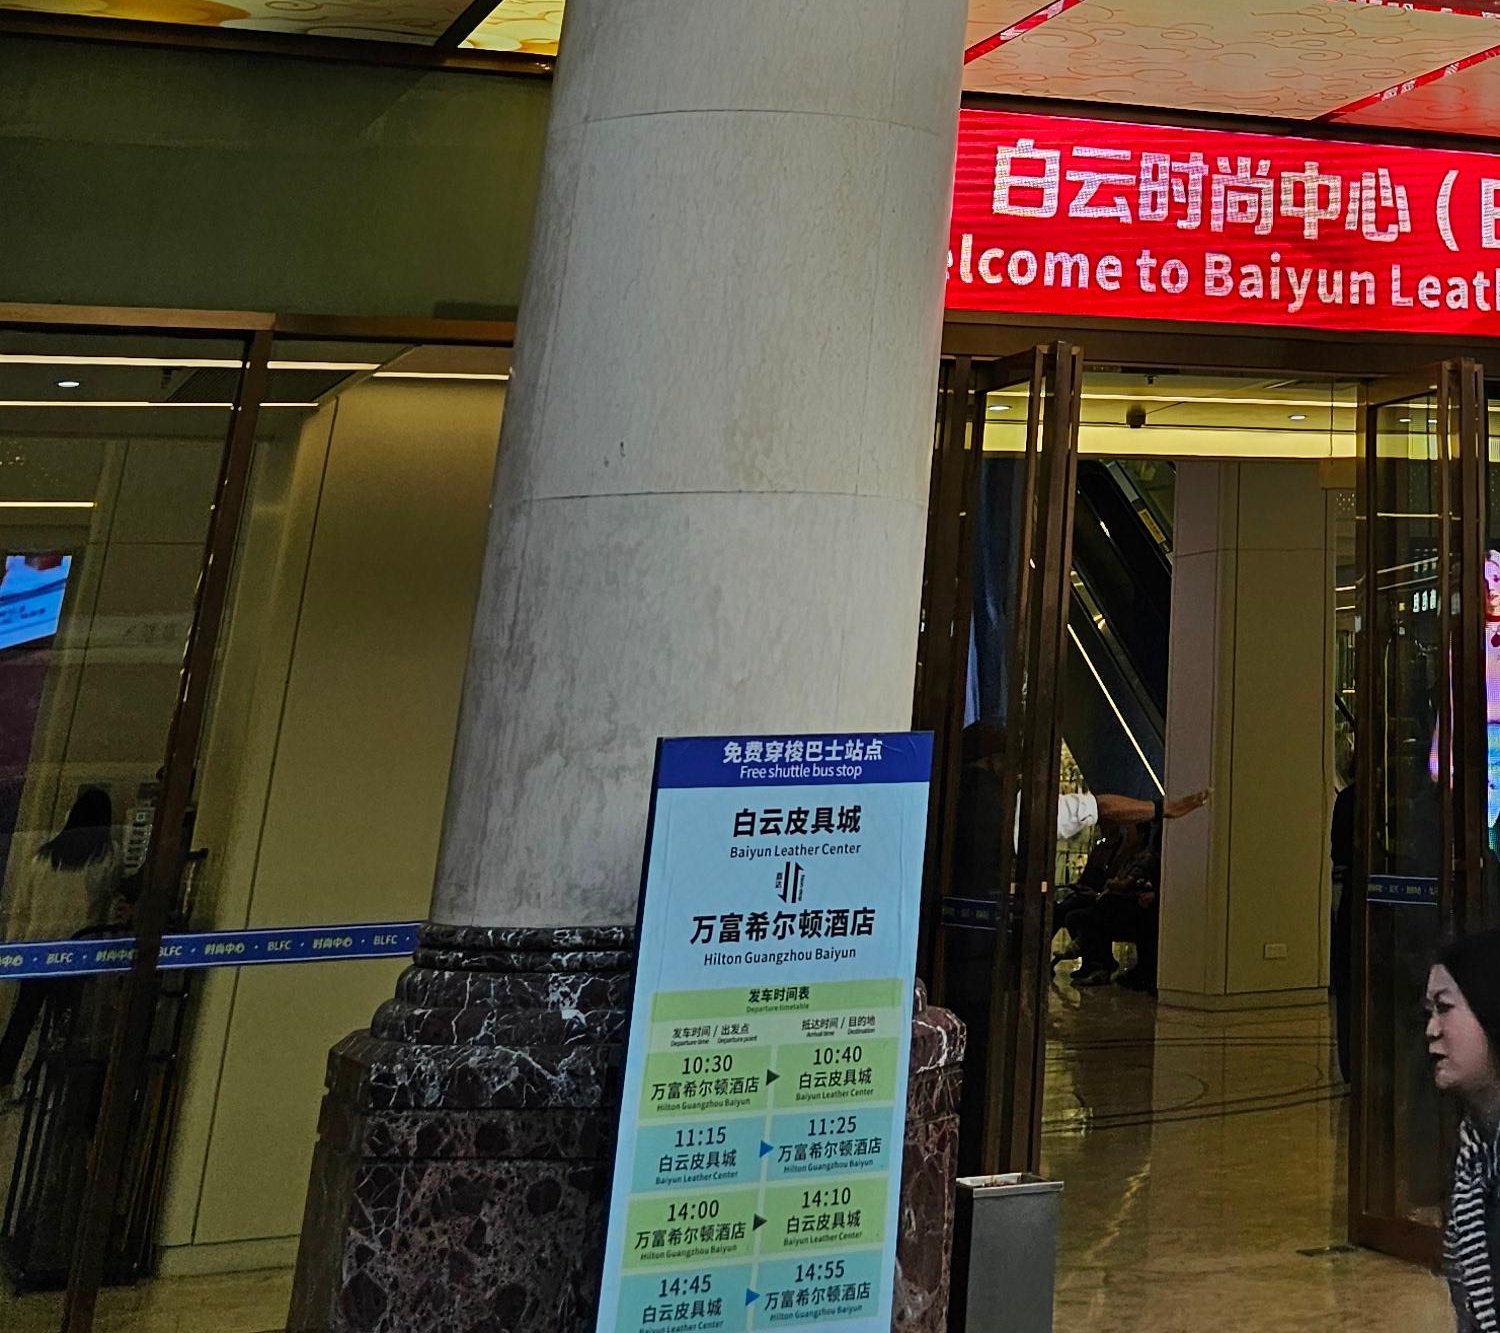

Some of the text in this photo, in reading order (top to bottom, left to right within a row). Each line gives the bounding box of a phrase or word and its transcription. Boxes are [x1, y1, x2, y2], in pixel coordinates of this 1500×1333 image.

[1137, 249, 1189, 294] to
[1203, 251, 1376, 313] Baiyun
[723, 740, 883, 764] 免费穿梭巴士站点
[740, 763, 863, 779] Free shuttle bus stop
[733, 805, 862, 837] 白云皮具城
[730, 842, 862, 861] Baiyun Leather Center
[690, 906, 876, 945] 万富希尔顿酒店
[267, 940, 293, 951] BLFC
[373, 934, 399, 946] BLFC
[46, 952, 73, 965] BLFC
[704, 946, 857, 966] Hilton Guangzhou Baiyun
[748, 986, 810, 1003] 发车时间表
[672, 1025, 712, 1039] 发车时间
[720, 1023, 750, 1036] 出发点
[848, 1014, 876, 1028] 目的地
[682, 1054, 733, 1075] 10:30
[813, 1045, 862, 1065] 10:40
[651, 1076, 760, 1101] 万富希尔顿酒店
[799, 1067, 872, 1090] 白云皮具城
[682, 1100, 723, 1111] Guangzhou
[725, 1098, 751, 1108] Baiyun
[675, 1126, 726, 1148] 11:15
[808, 1116, 857, 1137] 11:25
[659, 1148, 737, 1173] 白云皮具城
[778, 1137, 882, 1163] 万富希尔顿酒店
[802, 1187, 851, 1209] 14:10
[667, 1199, 719, 1222] 14:00
[787, 1209, 861, 1234] 白云皮具城
[634, 1222, 746, 1250] 万富希尔顿酒店
[795, 1260, 845, 1283] 14:55
[659, 1274, 711, 1298] 14:45
[764, 1282, 871, 1311] 万富希尔顿酒店
[642, 1297, 722, 1324] 白云皮具城
